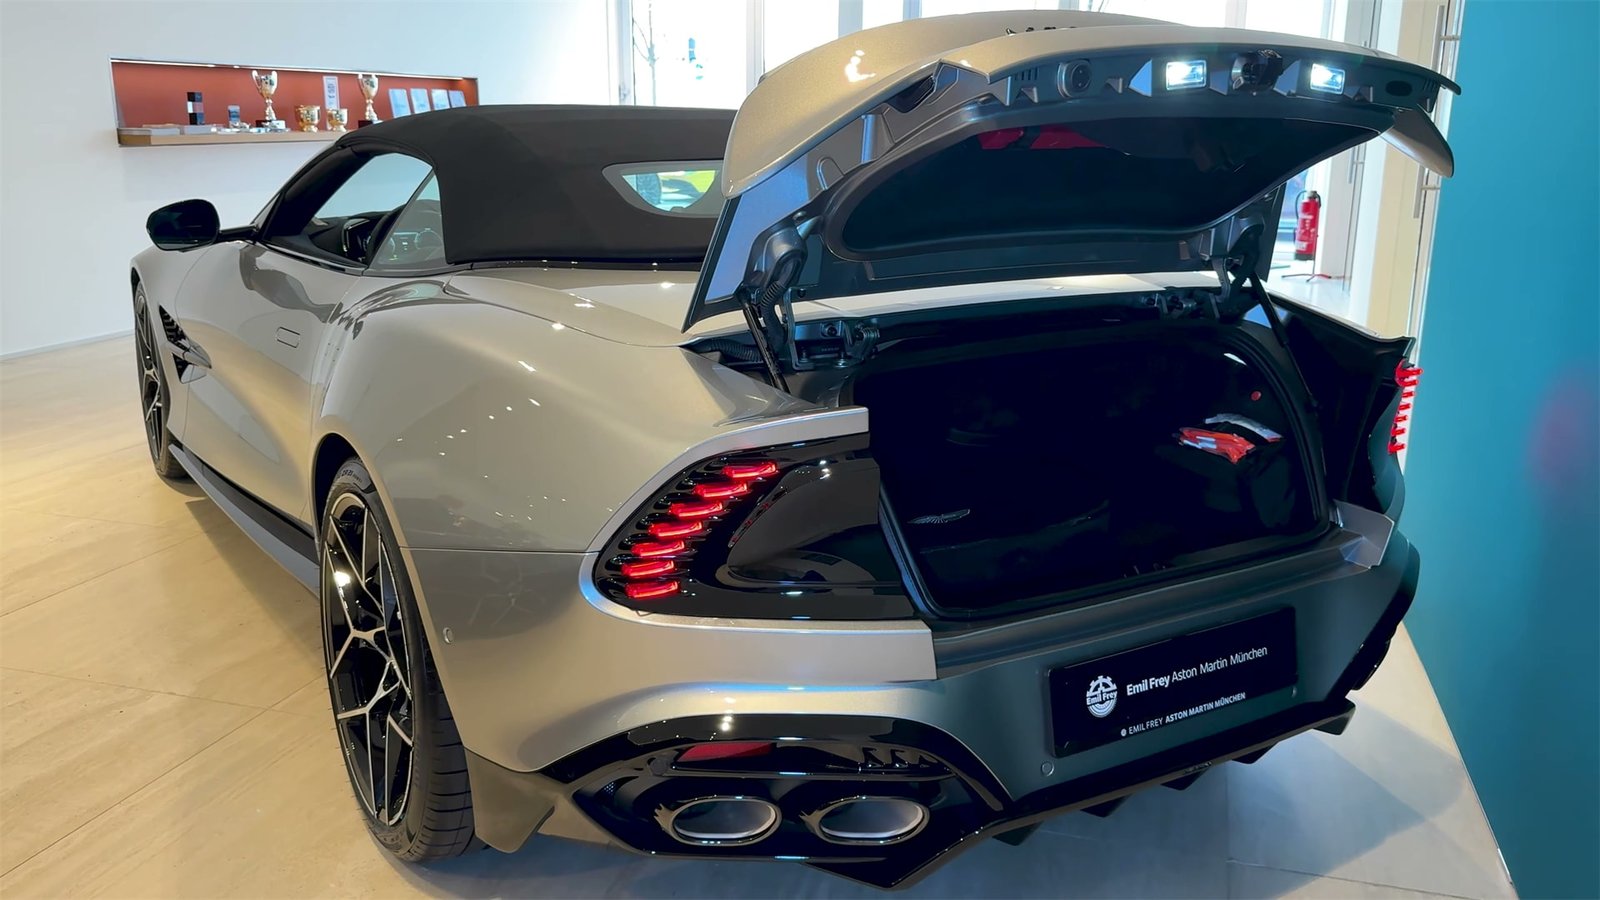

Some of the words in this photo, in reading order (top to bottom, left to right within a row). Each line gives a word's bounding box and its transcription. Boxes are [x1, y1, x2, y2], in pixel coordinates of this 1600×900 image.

[1127, 679, 1148, 696] Emil
[1149, 675, 1170, 689] Frey
[1171, 667, 1197, 682] Aston
[1200, 657, 1228, 674] Martin
[1230, 647, 1268, 665] München
[1102, 688, 1117, 701] Frey
[1128, 723, 1145, 734] EMIL
[1146, 718, 1163, 729] FREY
[1165, 710, 1188, 723] ASTON
[1188, 702, 1214, 716] MARTIN
[1214, 692, 1246, 708] MÜNCHEN
